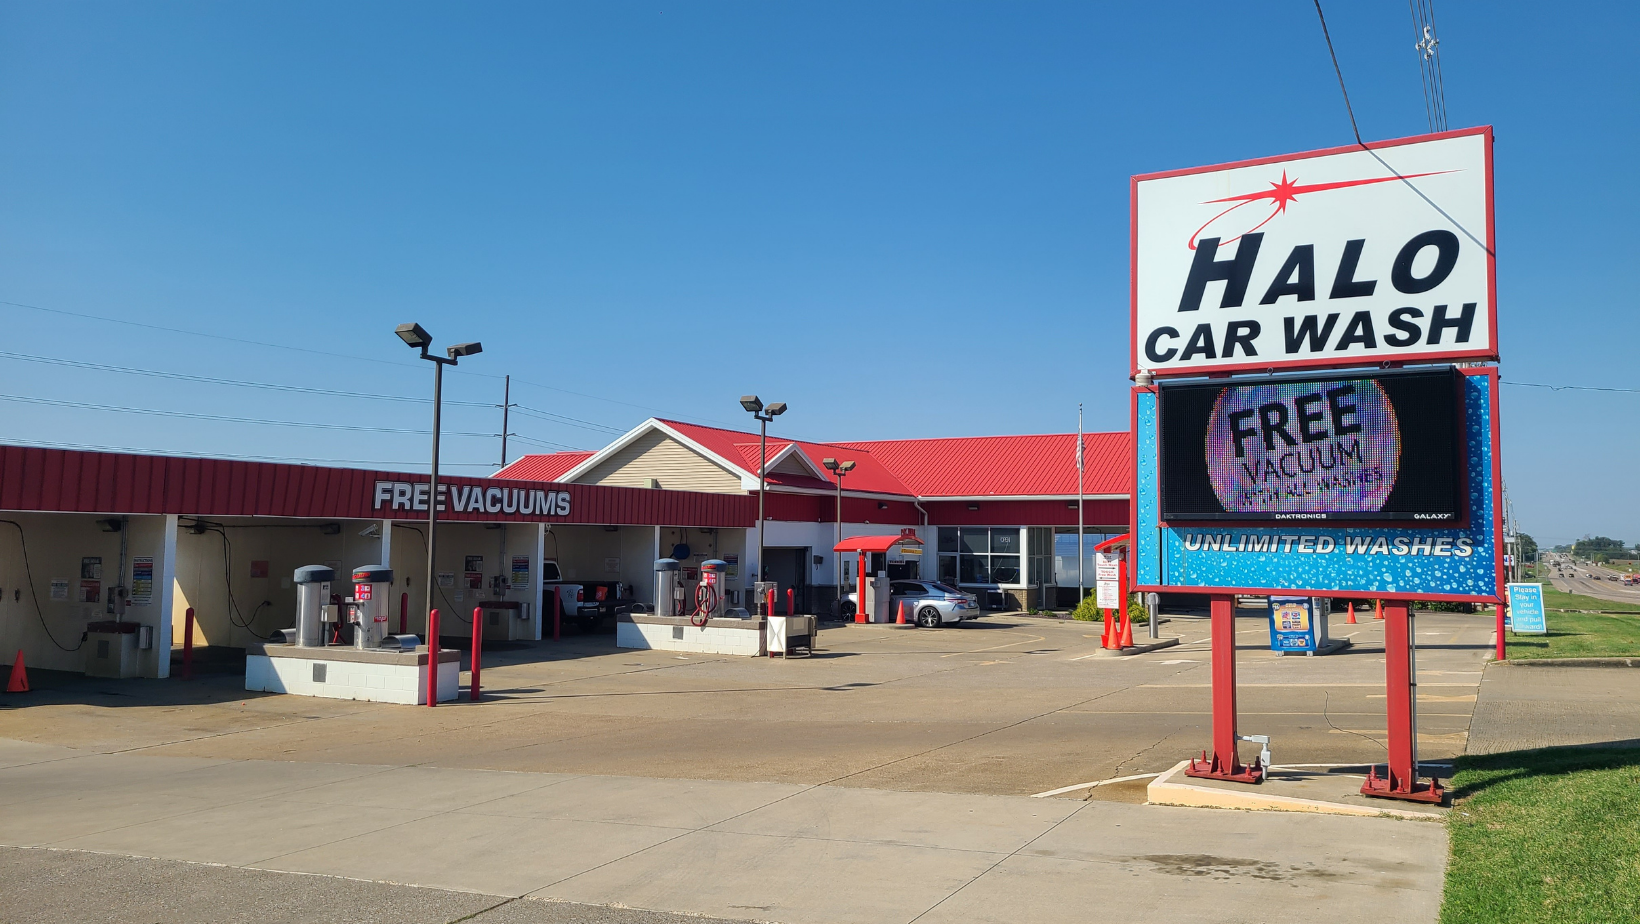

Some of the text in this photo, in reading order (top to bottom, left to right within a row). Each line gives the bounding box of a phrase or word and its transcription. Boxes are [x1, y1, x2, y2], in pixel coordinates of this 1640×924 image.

[1178, 230, 1460, 312] HALO
[1144, 302, 1477, 363] CAR WASH
[1228, 384, 1362, 458] FREE
[1242, 438, 1362, 484] VACUUM
[374, 480, 570, 516] FREE VACUUMS
[1184, 533, 1474, 556] UNLIMITED WASHES
